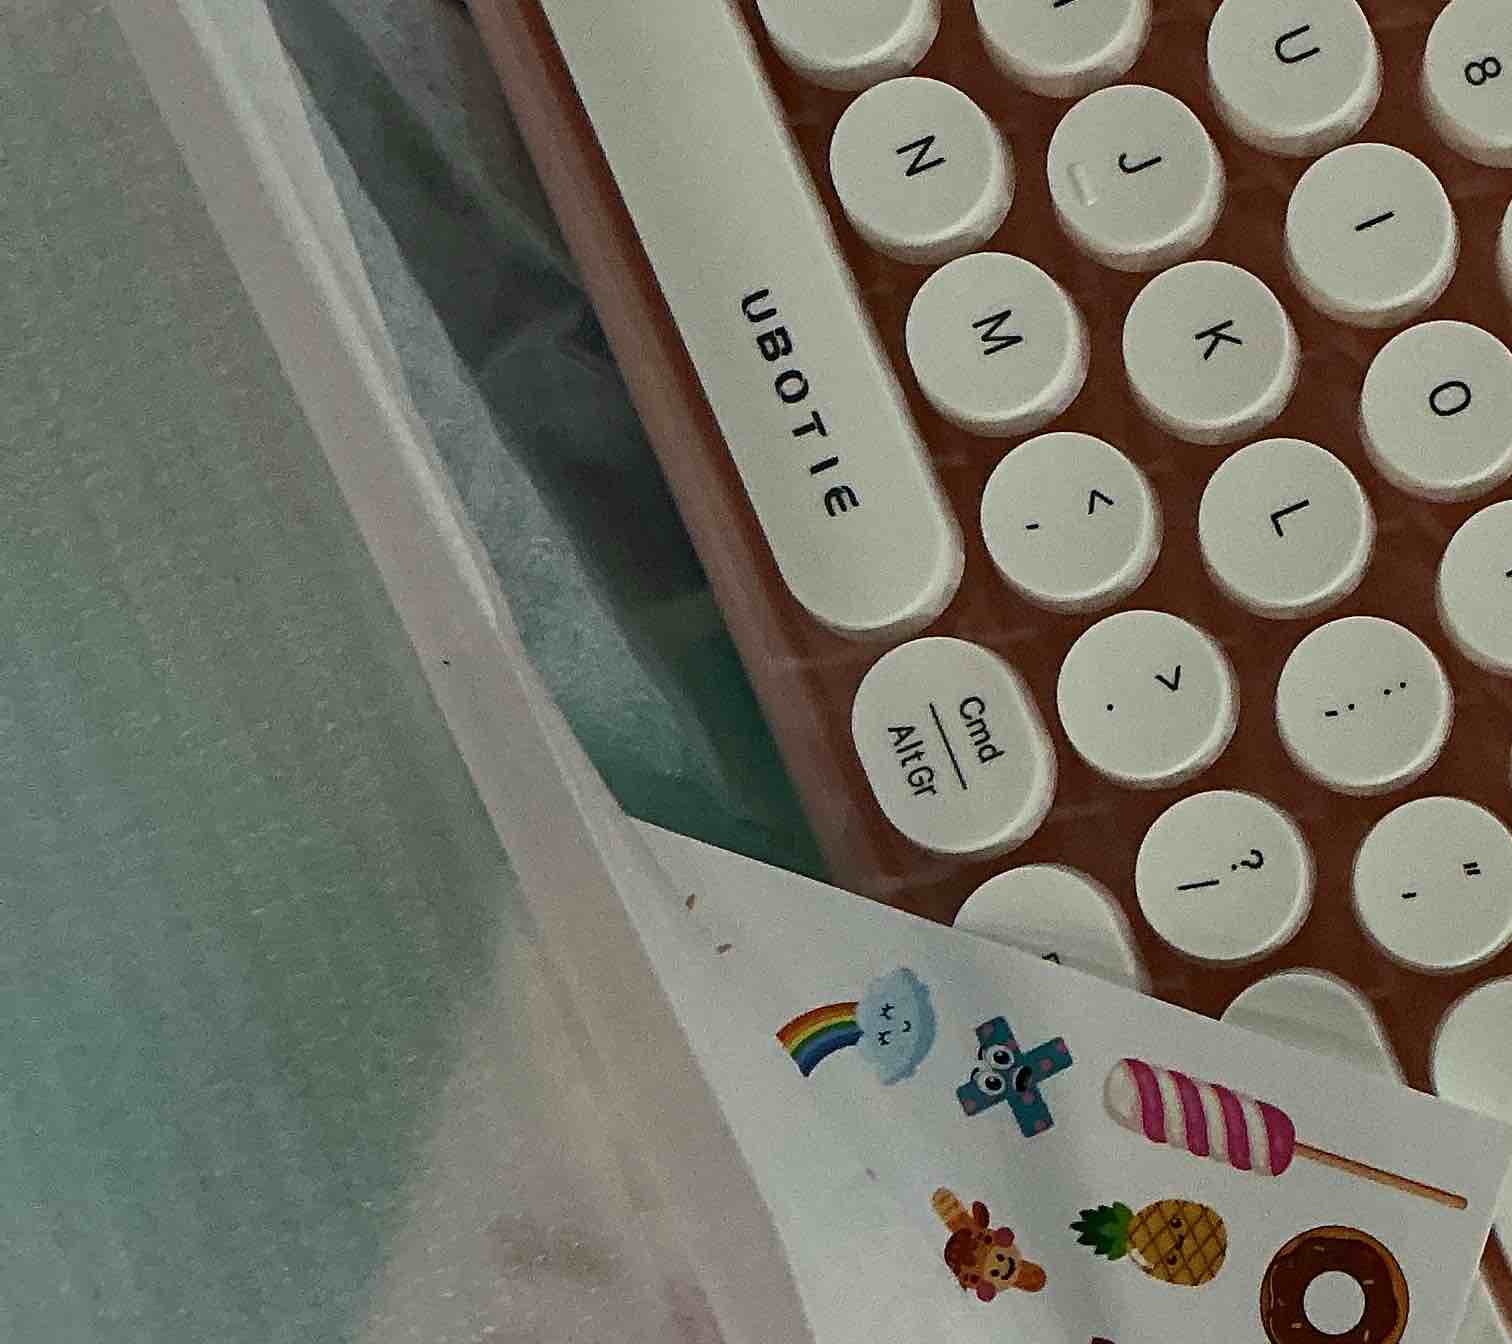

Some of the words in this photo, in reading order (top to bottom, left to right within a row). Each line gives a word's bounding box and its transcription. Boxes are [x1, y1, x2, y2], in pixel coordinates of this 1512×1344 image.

[1275, 24, 1320, 64] U
[1464, 57, 1502, 86] 8
[896, 136, 946, 176] N
[1118, 153, 1162, 174] J
[1355, 211, 1394, 231] I
[972, 310, 1023, 355] M
[1195, 320, 1242, 360] K
[742, 289, 859, 517] UBOTIE
[1429, 381, 1471, 416] O
[1088, 490, 1114, 515] <
[1271, 499, 1309, 537] L
[1155, 665, 1181, 691] >
[960, 696, 1005, 764] Cmd
[888, 726, 938, 796] AltGr
[1231, 849, 1264, 871] ?
